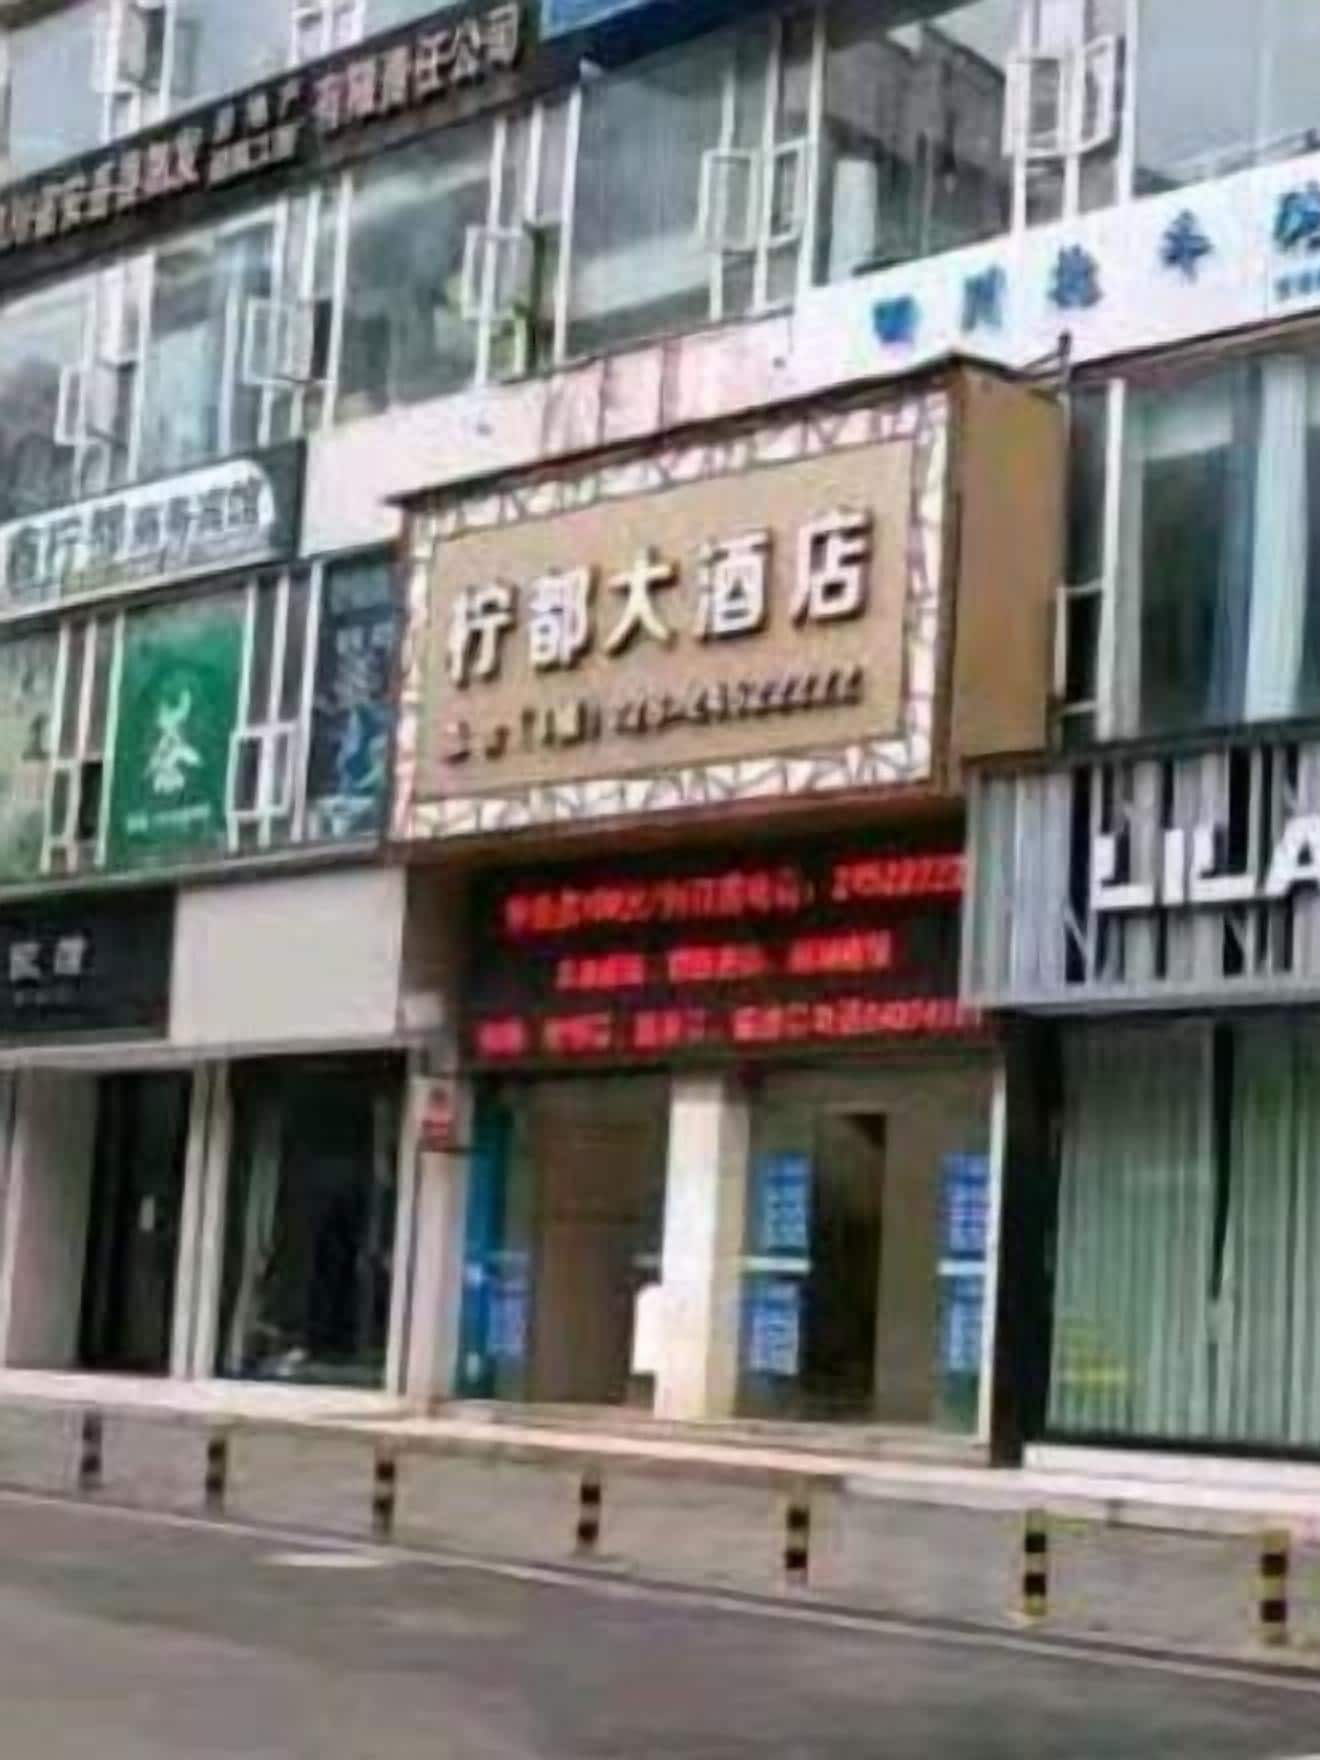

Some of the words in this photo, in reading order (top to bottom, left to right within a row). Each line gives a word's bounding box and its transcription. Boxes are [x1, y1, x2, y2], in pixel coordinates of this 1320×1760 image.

[448, 505, 874, 690] 柠都大酒店
